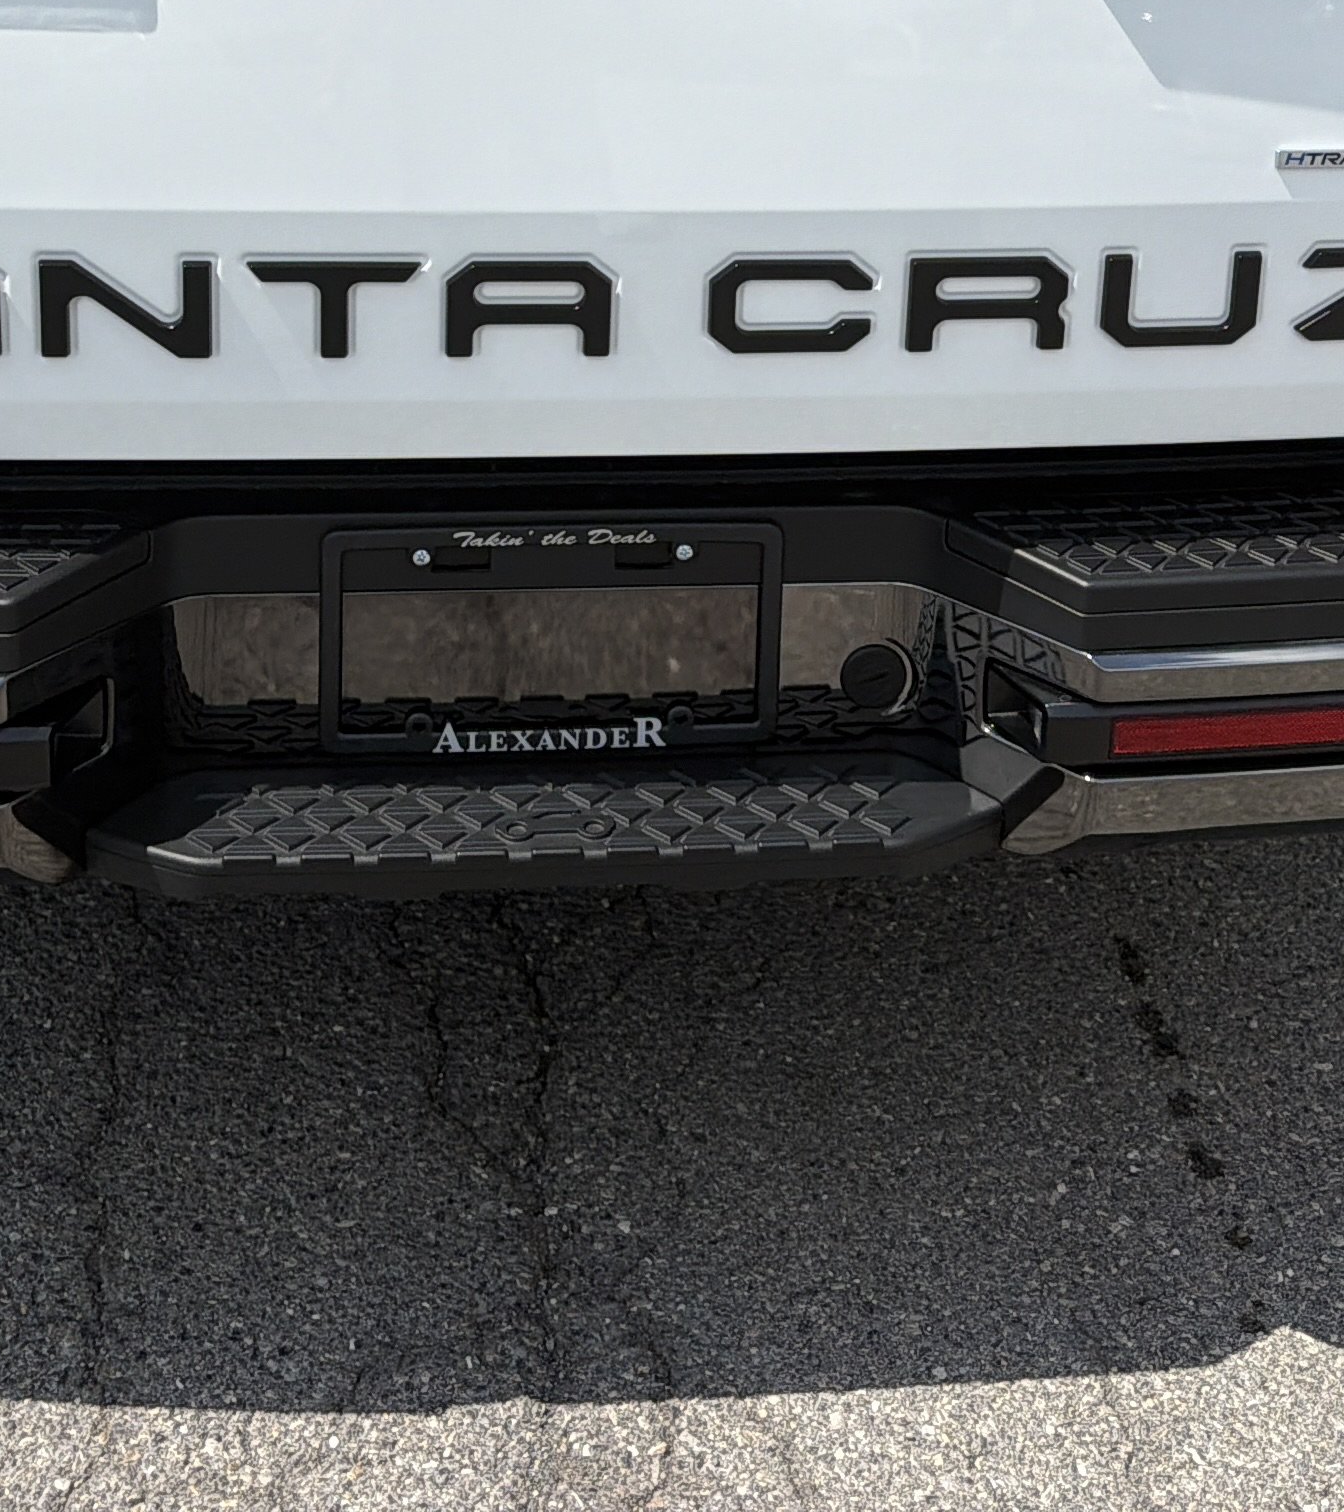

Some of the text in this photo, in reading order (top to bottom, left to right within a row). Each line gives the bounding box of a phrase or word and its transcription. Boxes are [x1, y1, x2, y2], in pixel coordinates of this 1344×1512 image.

[452, 528, 657, 548] Takin' the Deals
